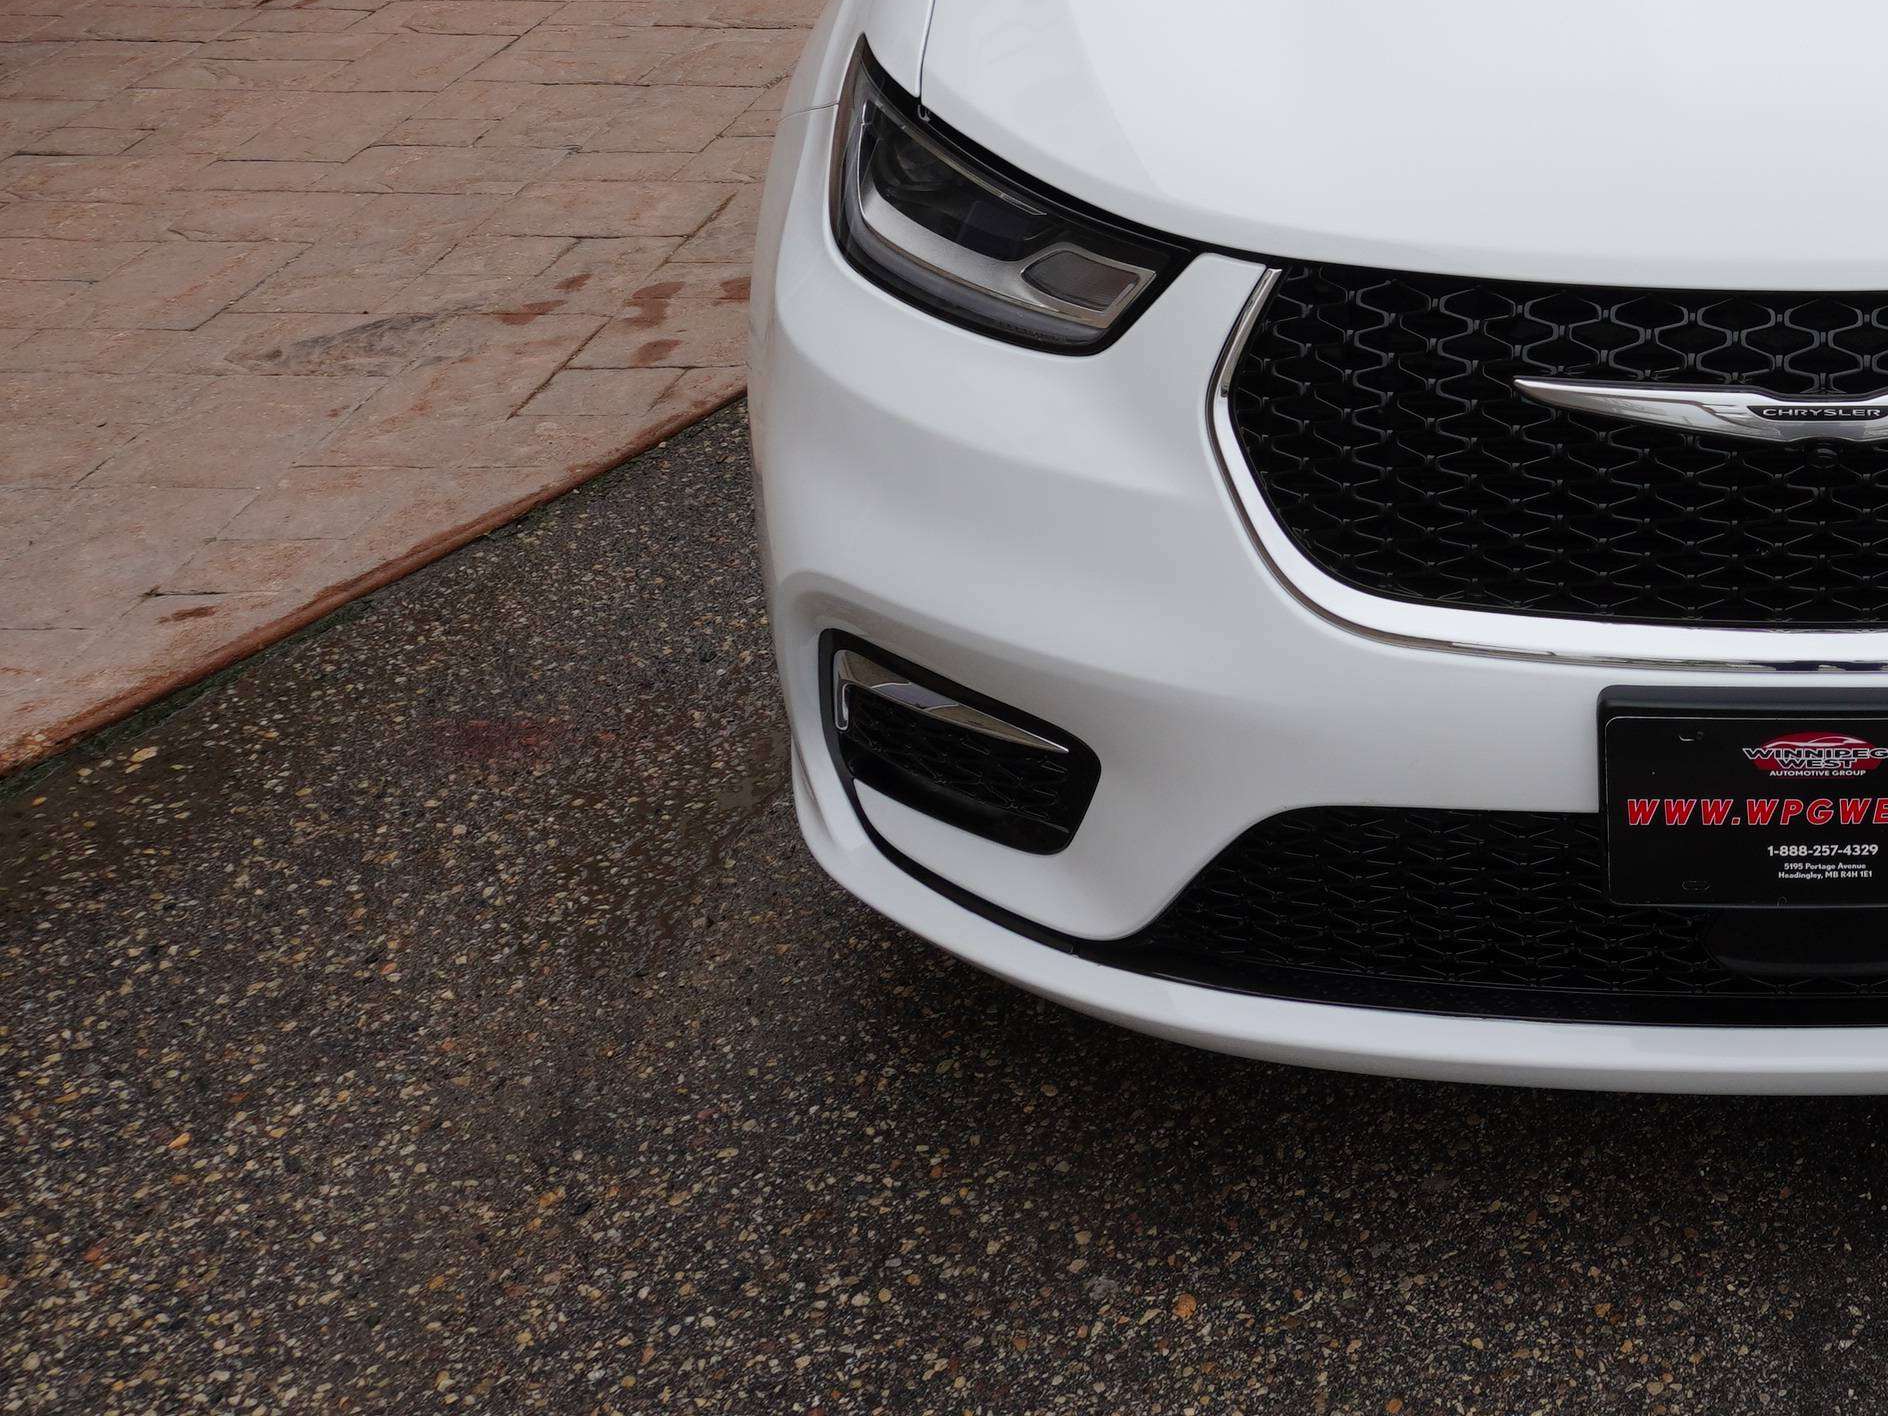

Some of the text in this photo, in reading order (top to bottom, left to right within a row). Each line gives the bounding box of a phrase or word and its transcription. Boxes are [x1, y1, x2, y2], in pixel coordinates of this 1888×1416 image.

[1762, 408, 1881, 417] CHRYSLER
[1775, 758, 1858, 769] WEST
[1769, 769, 1867, 777] AUTOMOTIVE GROUP
[1767, 844, 1879, 857] 1-888-257-4329
[1805, 863, 1836, 871] Portage
[1837, 862, 1867, 870] Avenue
[1778, 870, 1873, 879] Headingley, MB R4H 1E1
